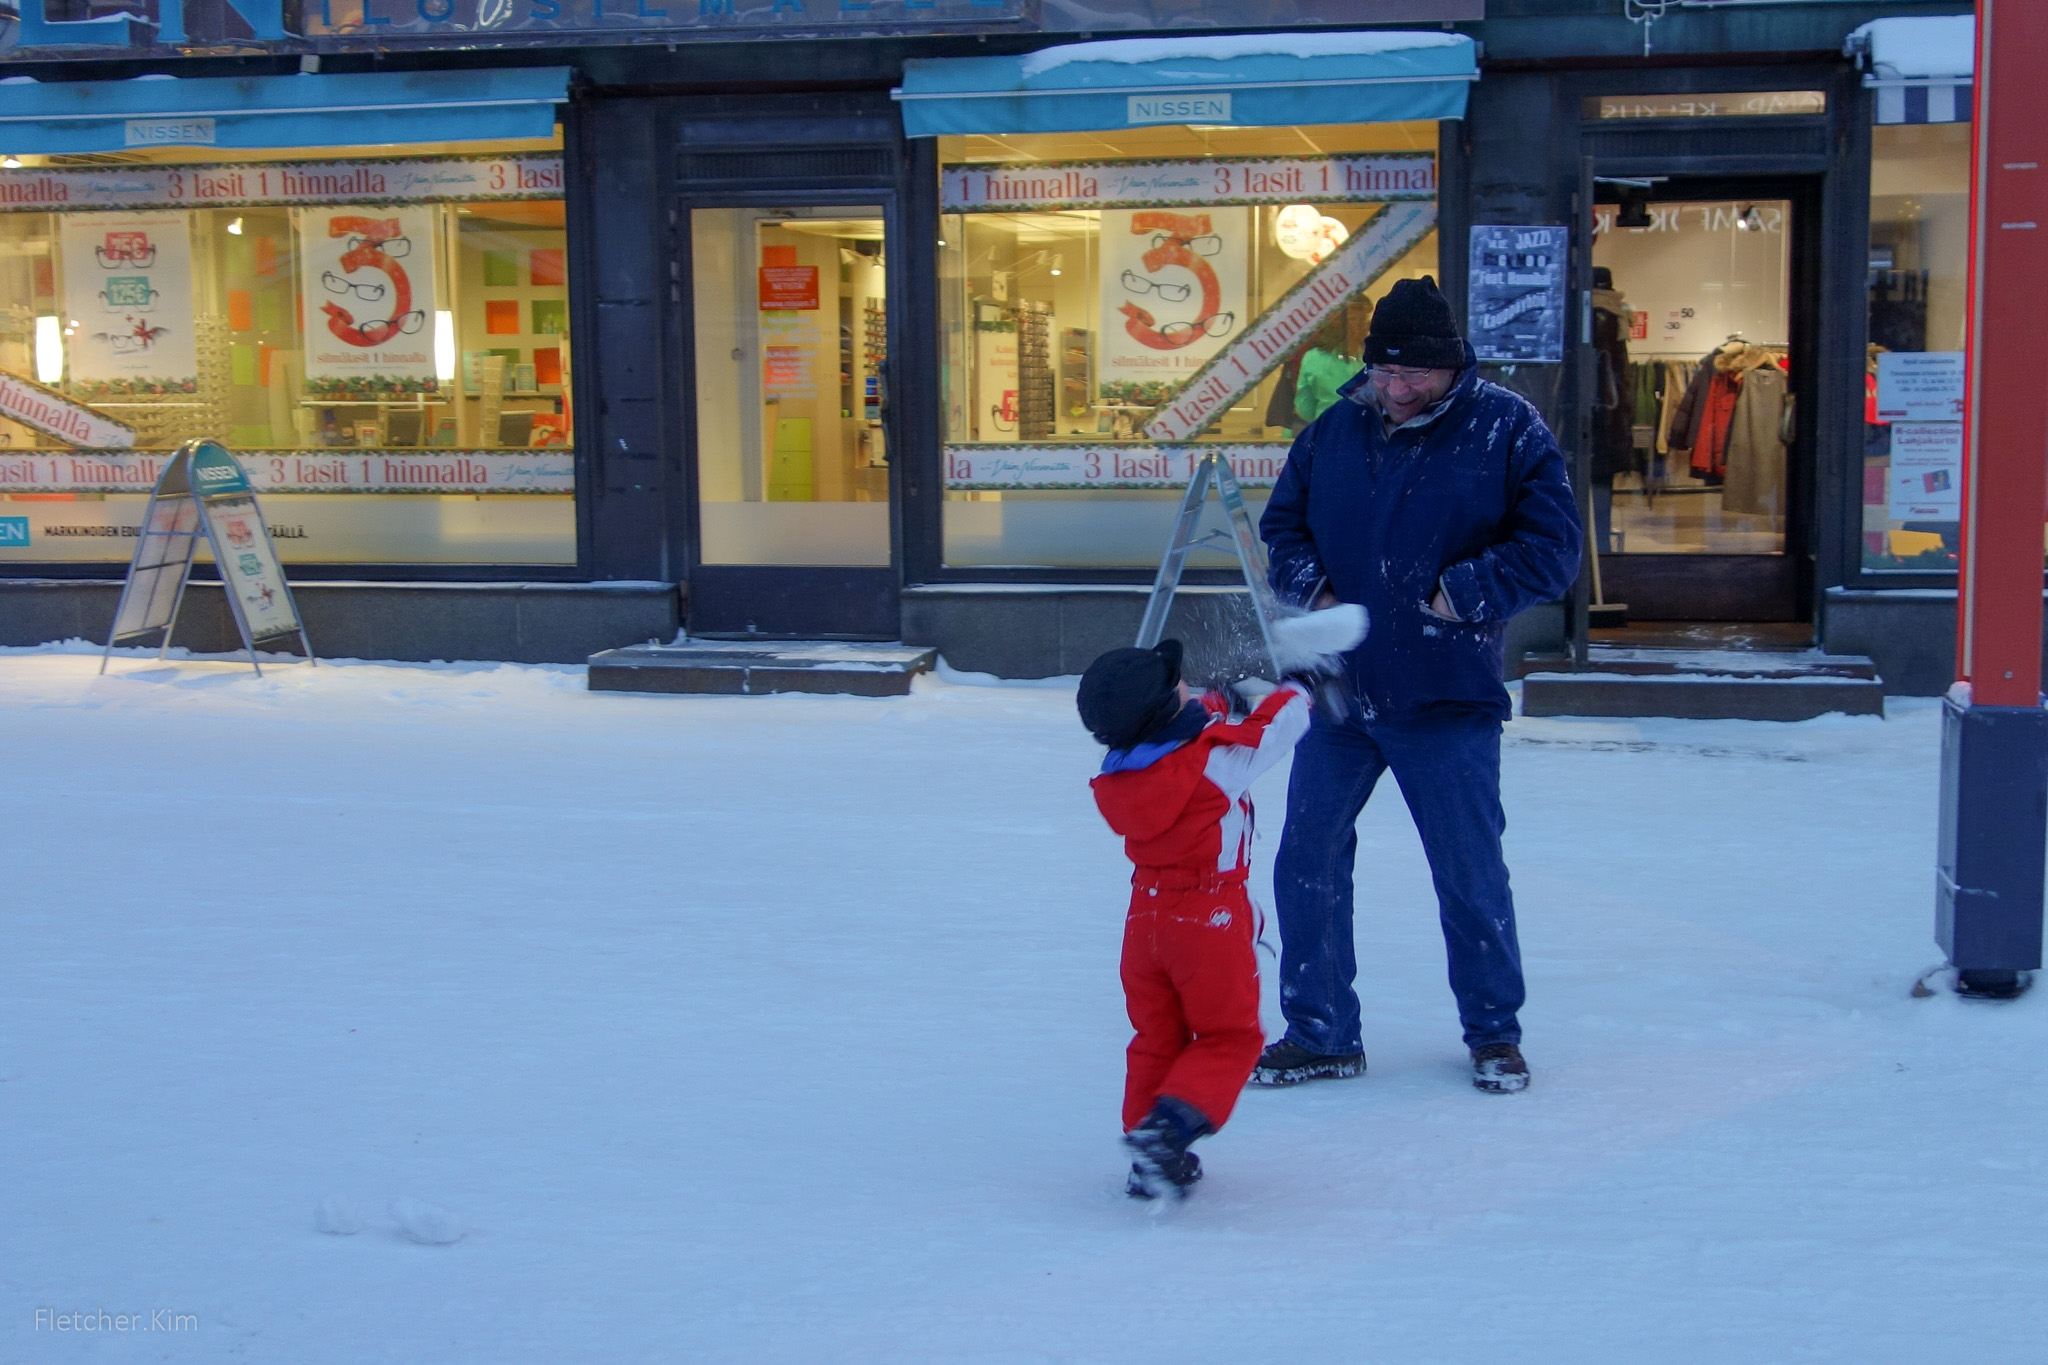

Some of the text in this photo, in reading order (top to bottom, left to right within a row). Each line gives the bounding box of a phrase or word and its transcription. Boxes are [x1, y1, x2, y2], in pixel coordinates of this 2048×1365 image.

[1136, 101, 1224, 117] NISSEN
[134, 124, 210, 141] NISSEN
[168, 172, 184, 199] 3
[194, 172, 248, 198] lasit
[258, 171, 270, 196] 1
[281, 168, 387, 195] hinnalla
[488, 163, 506, 191] 3
[516, 162, 563, 189] lasi
[960, 174, 969, 201] 1
[985, 171, 1098, 200] hinnalla
[1214, 166, 1231, 195] 3
[1244, 166, 1306, 194] lasit
[1317, 164, 1330, 192] 1
[382, 352, 427, 363] hinnalla
[1151, 270, 1352, 441] 3 lasit 1 hinnalla
[0, 380, 91, 442] hinnalla
[50, 459, 59, 483] 1
[196, 465, 239, 482] NISSEN
[270, 458, 285, 484] 3
[295, 458, 348, 484] lasit
[361, 458, 371, 484] 1
[384, 458, 488, 484] hinnalla
[1085, 452, 1101, 479] 3
[1113, 452, 1173, 479] lasit
[44, 525, 120, 538] MARKKINOIDEN
